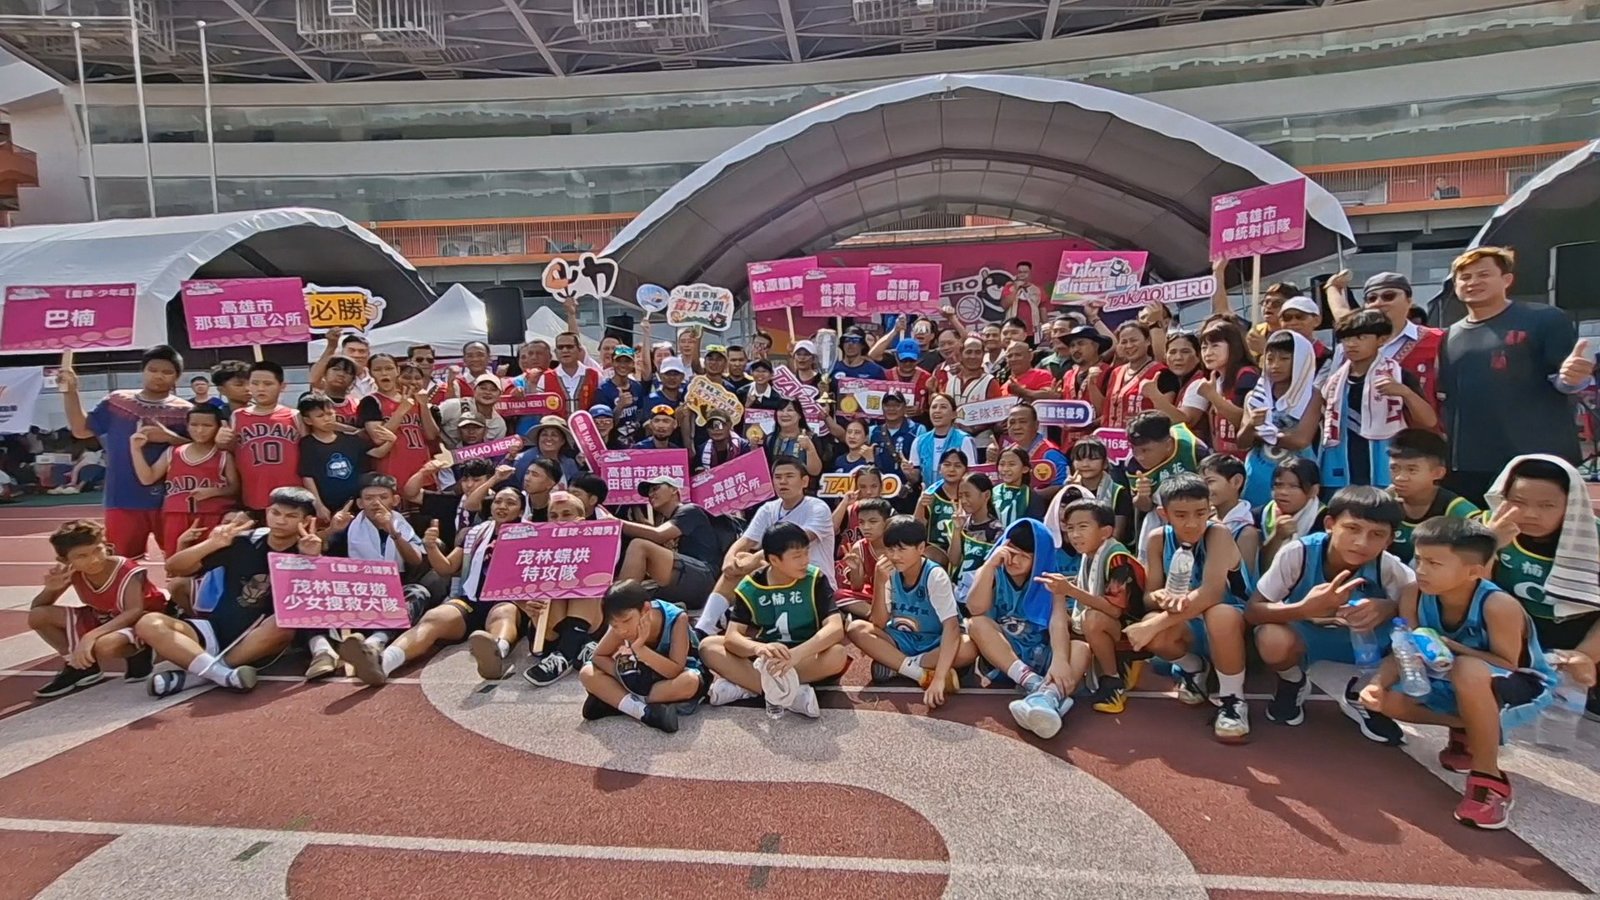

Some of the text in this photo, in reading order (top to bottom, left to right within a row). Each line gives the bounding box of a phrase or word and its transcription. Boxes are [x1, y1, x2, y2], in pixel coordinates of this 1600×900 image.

[1235, 205, 1277, 226] 高雄市
[887, 279, 920, 290] 高雄市
[941, 279, 979, 293] ERO
[219, 299, 273, 314] 高雄市
[310, 298, 363, 321] 必勝
[45, 309, 95, 328] 巴楠
[194, 312, 302, 331] 那瑪夏區公所
[402, 427, 424, 450] 11
[250, 441, 283, 466] 10
[458, 444, 491, 461] TAKAO
[607, 465, 684, 478] 高雄市茂林區
[164, 475, 227, 497] PADA
[703, 477, 760, 509] 茂林區公所
[712, 472, 746, 495] 高雄市
[821, 476, 898, 495] TAO
[521, 564, 578, 582] 特攻隊
[290, 579, 388, 597] 茂林區夜遊
[283, 594, 400, 612] 少女搜救犬隊
[758, 591, 803, 606] 巴楠花
[766, 611, 793, 642] 1
